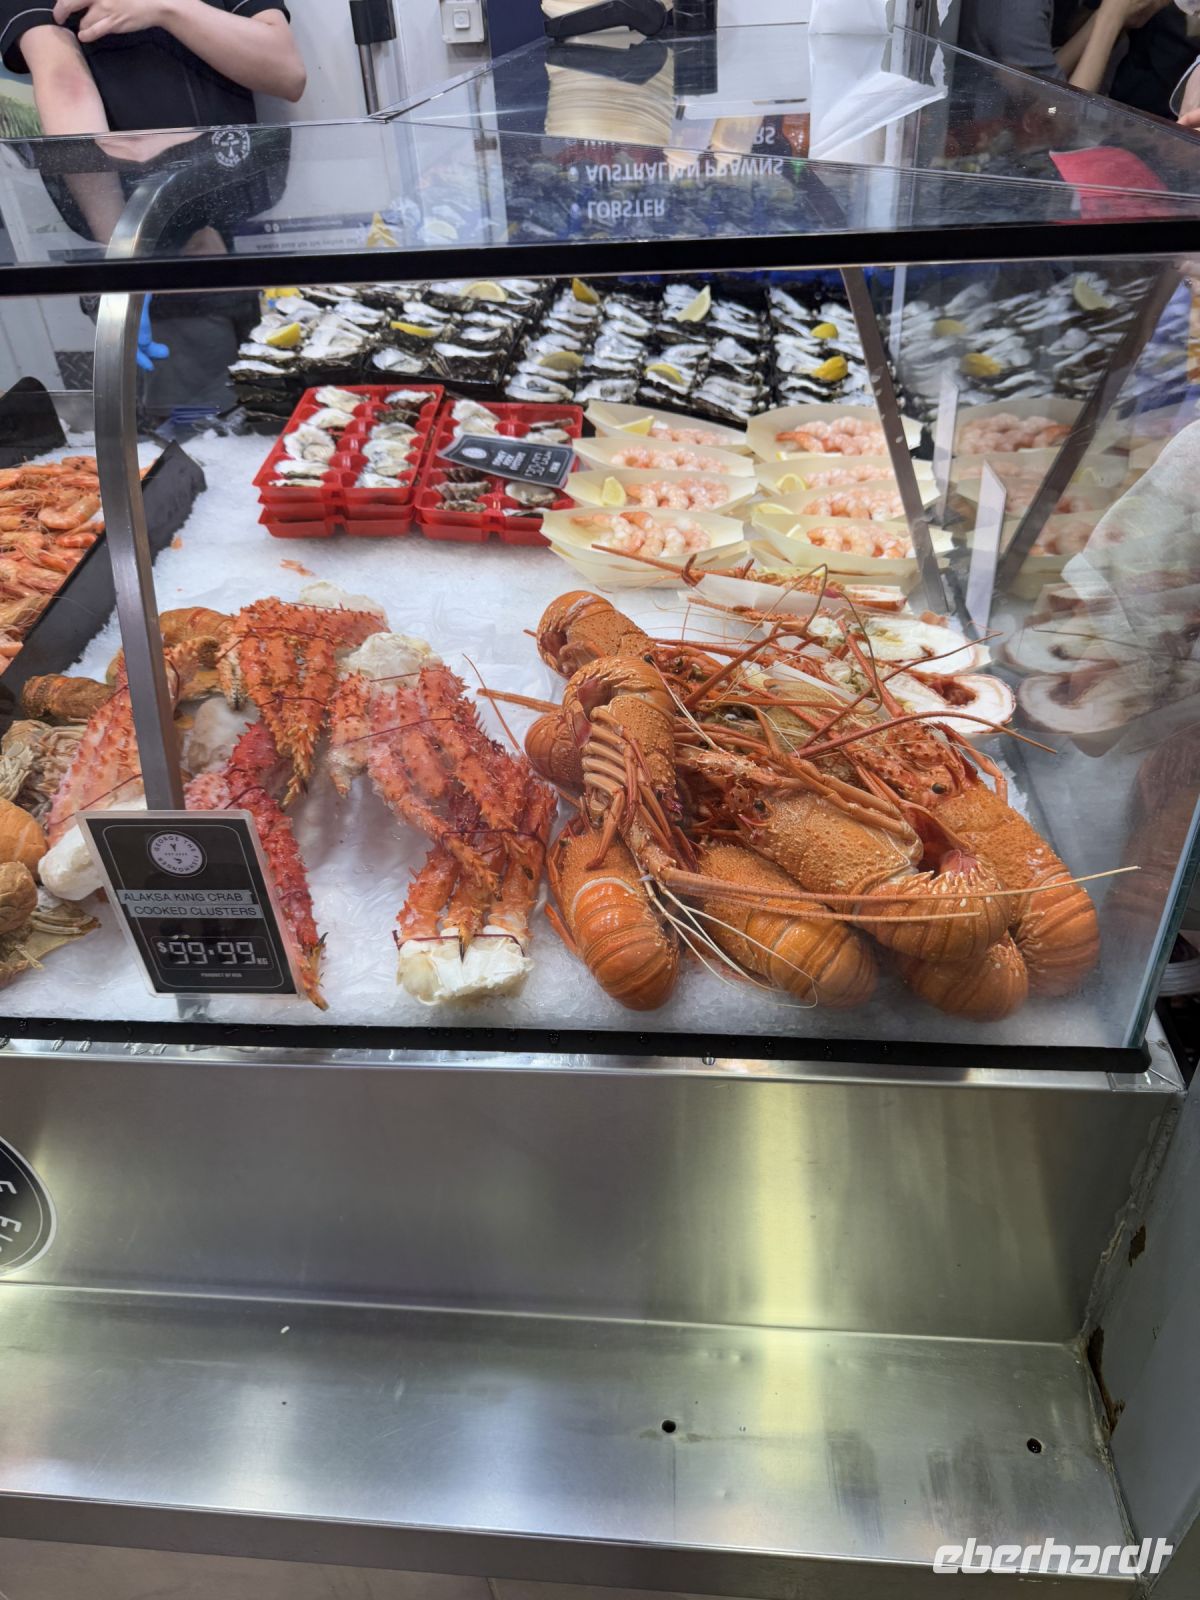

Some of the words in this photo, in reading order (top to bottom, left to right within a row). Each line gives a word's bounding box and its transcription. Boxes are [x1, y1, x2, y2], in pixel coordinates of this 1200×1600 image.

[154, 835, 180, 851] GEORGE
[124, 892, 171, 901] ALAKSA
[174, 892, 205, 902] KING
[207, 893, 243, 902] CRAB
[134, 906, 188, 916] COOKED
[190, 907, 257, 917] CLUSTERS
